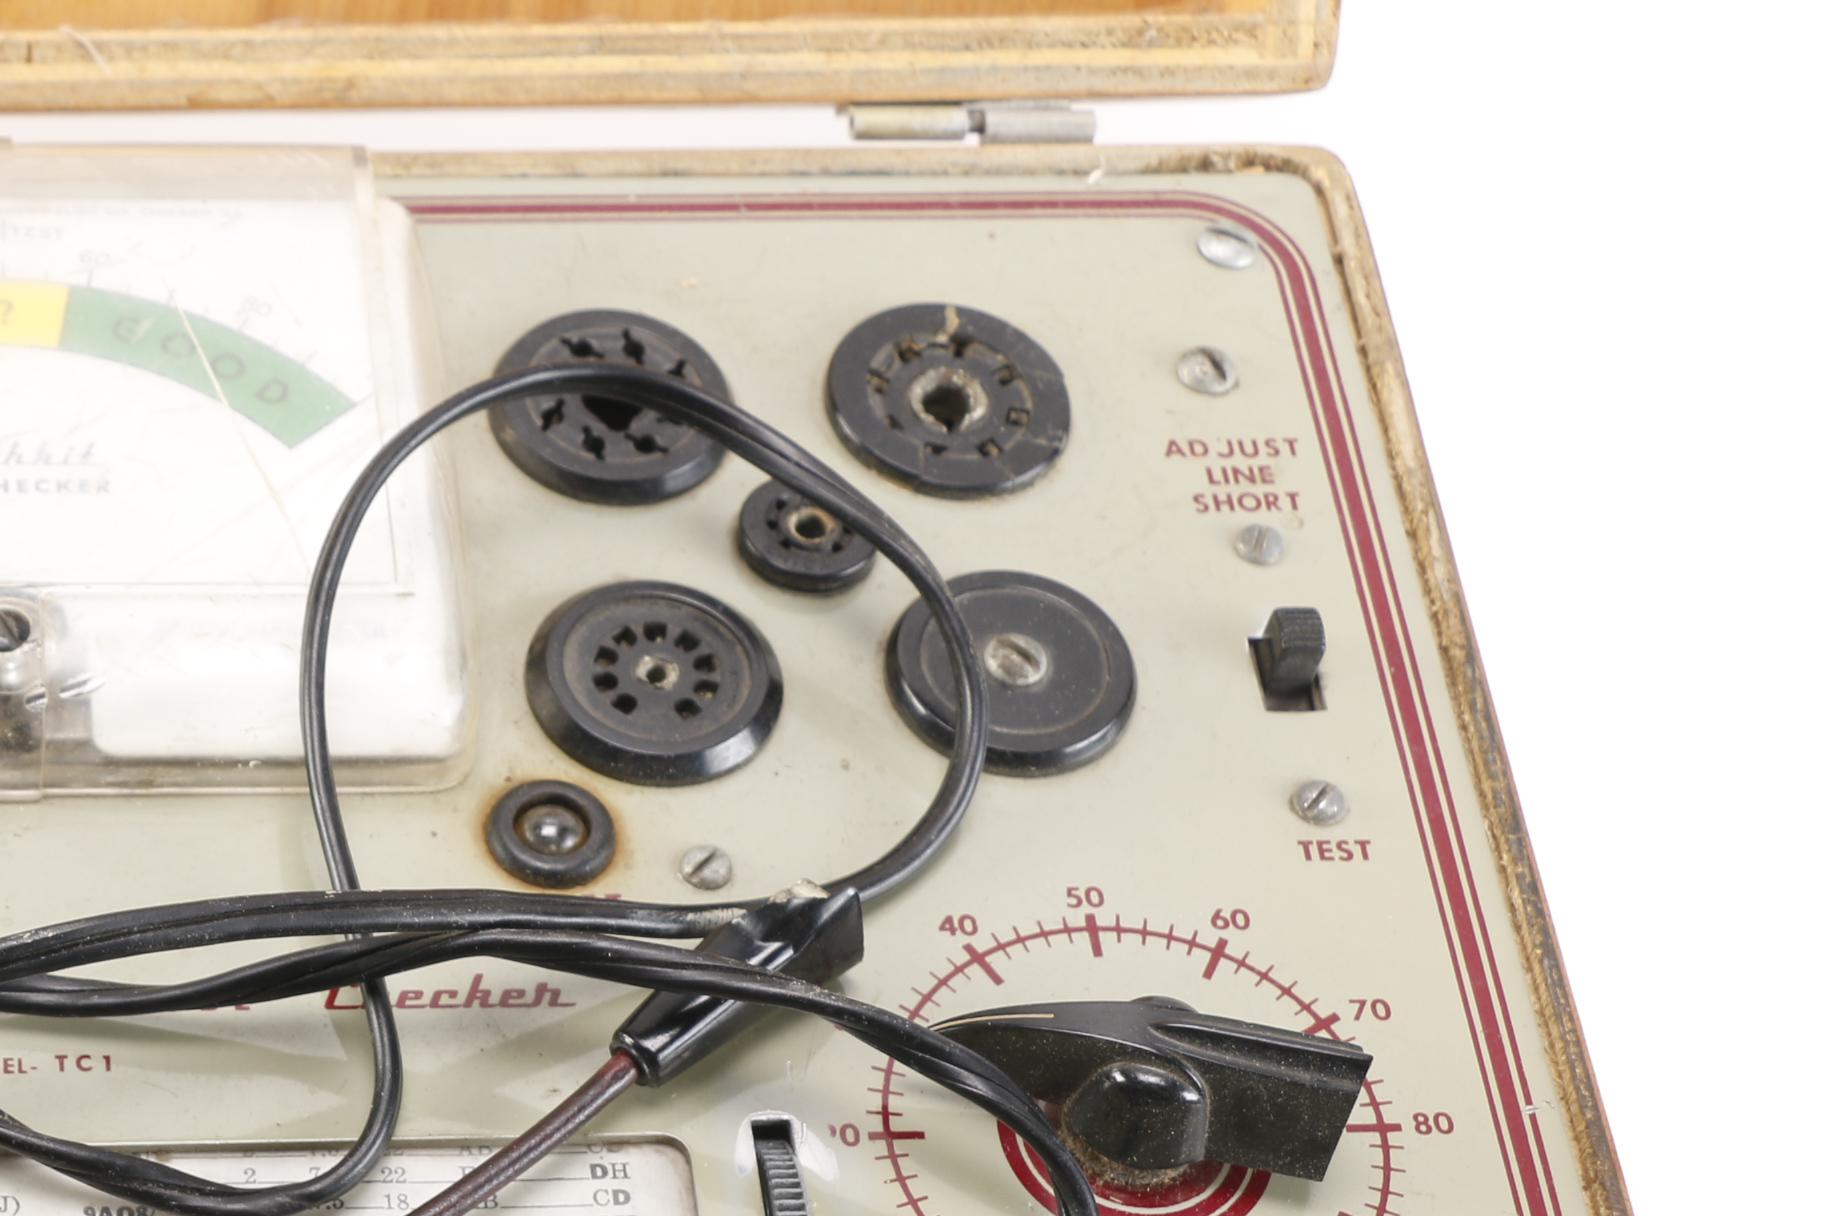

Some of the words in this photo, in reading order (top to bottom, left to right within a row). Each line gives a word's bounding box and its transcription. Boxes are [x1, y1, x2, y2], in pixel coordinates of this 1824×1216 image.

[111, 316, 291, 406] GOOD
[1165, 438, 1300, 459] ADJUST
[1206, 465, 1276, 485] LINE
[1193, 492, 1301, 513] SHORT
[1297, 840, 1372, 861] TEST
[1065, 885, 1104, 908] 50
[938, 913, 979, 938] 40
[1210, 908, 1251, 932] 60
[324, 973, 577, 1009] Cecker
[1349, 1000, 1392, 1022] 70
[1412, 1112, 1454, 1137] 80
[243, 1168, 257, 1183] 2
[381, 1167, 407, 1183] 22
[589, 1162, 631, 1180] DH
[384, 1194, 409, 1210] 18
[593, 1189, 631, 1206] CD
